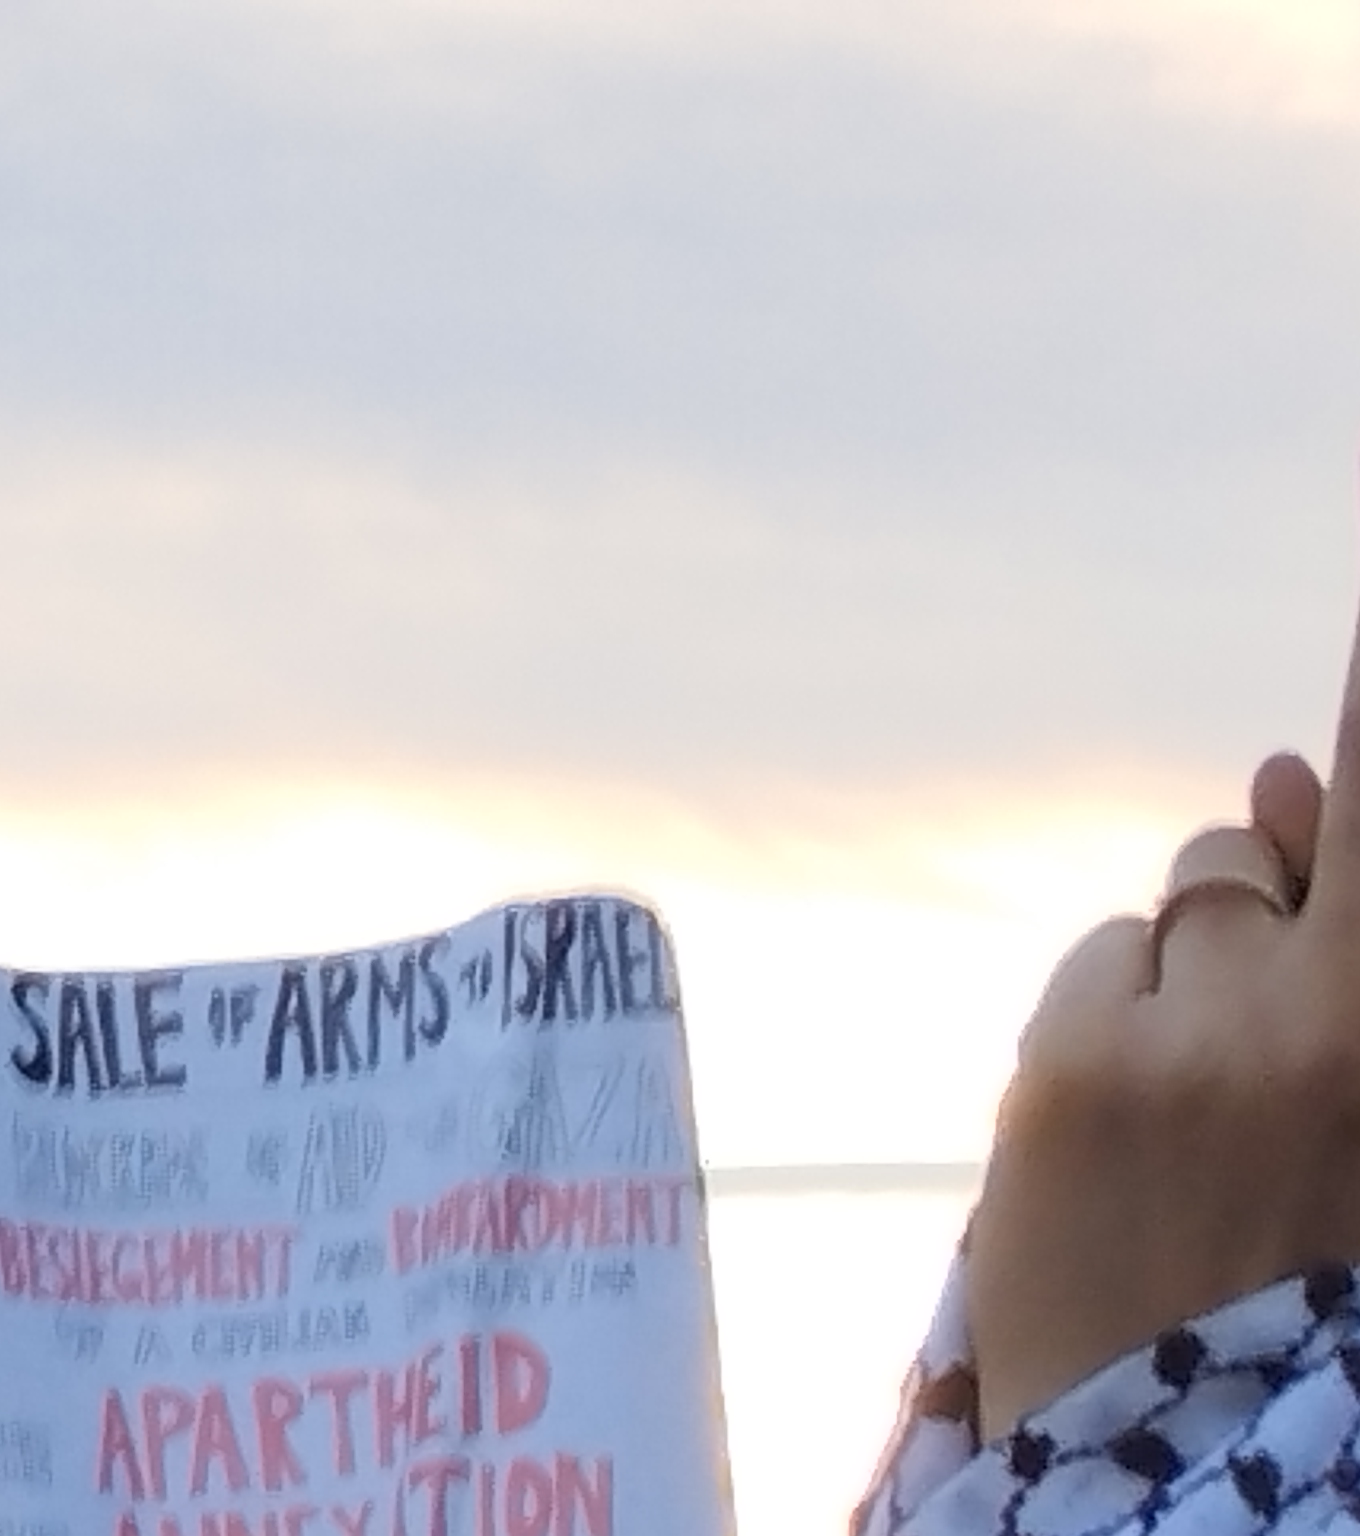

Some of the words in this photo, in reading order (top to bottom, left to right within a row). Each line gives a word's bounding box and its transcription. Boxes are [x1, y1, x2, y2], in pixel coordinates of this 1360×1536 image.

[8, 970, 186, 1097] SALE
[208, 984, 260, 1049] OF
[263, 933, 452, 1086] ARMS
[501, 899, 680, 1032] ISRAEL
[98, 1327, 553, 1500] APARTHEID
